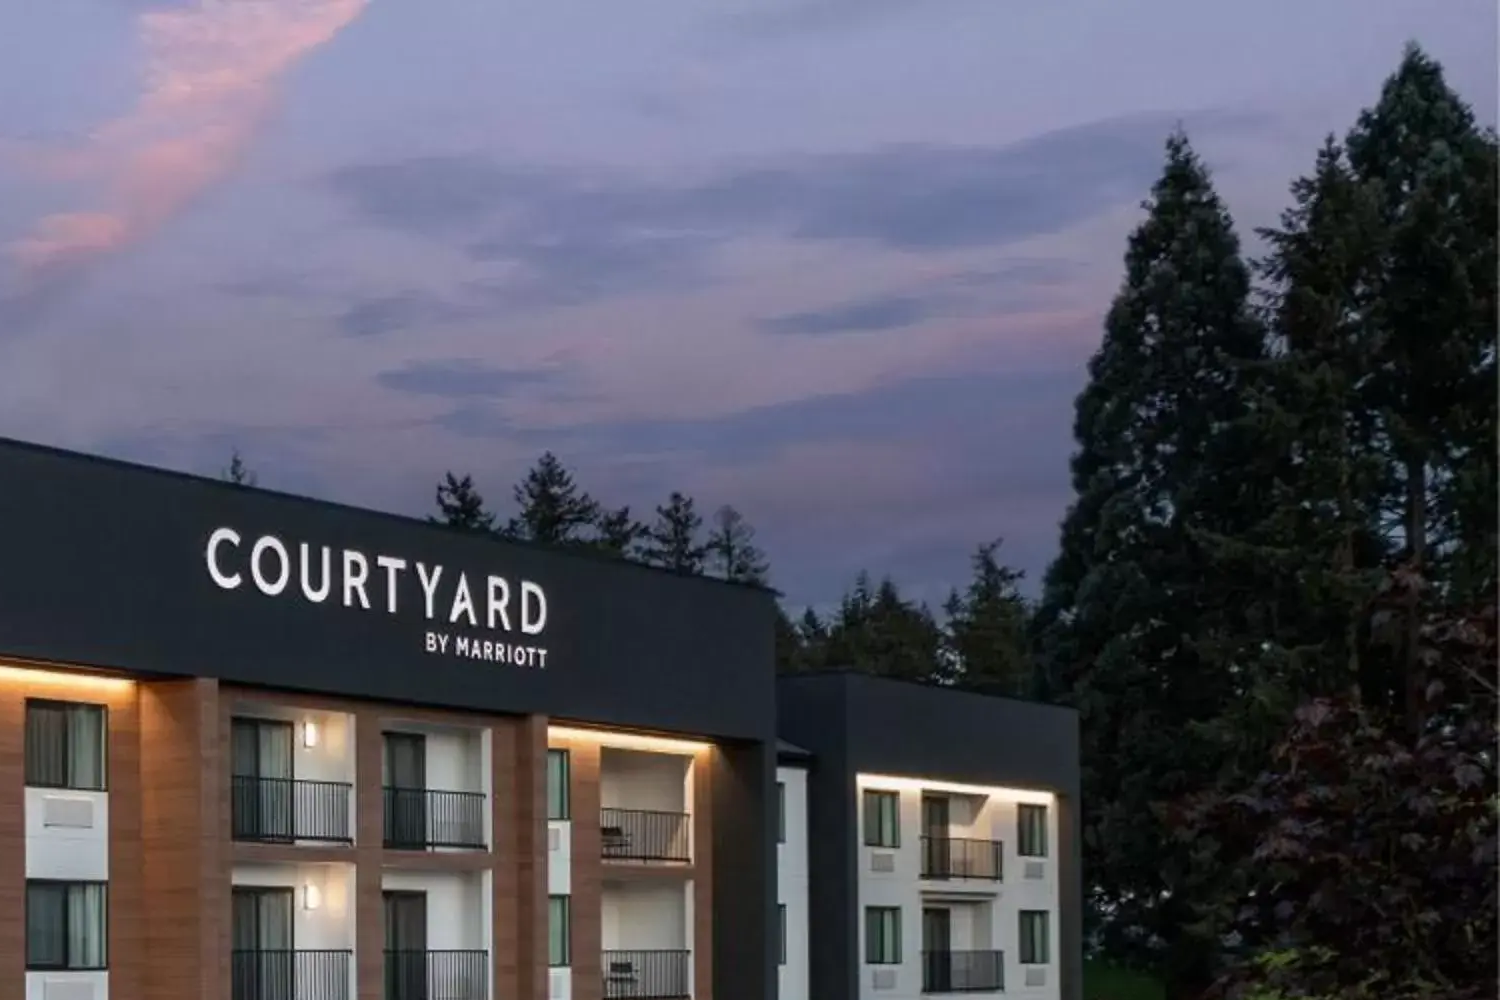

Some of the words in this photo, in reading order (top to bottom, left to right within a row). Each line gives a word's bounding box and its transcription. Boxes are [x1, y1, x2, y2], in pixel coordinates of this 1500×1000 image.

[205, 526, 548, 636] COURTYARD
[425, 631, 449, 654] BY
[455, 635, 548, 669] MARRIOTT
